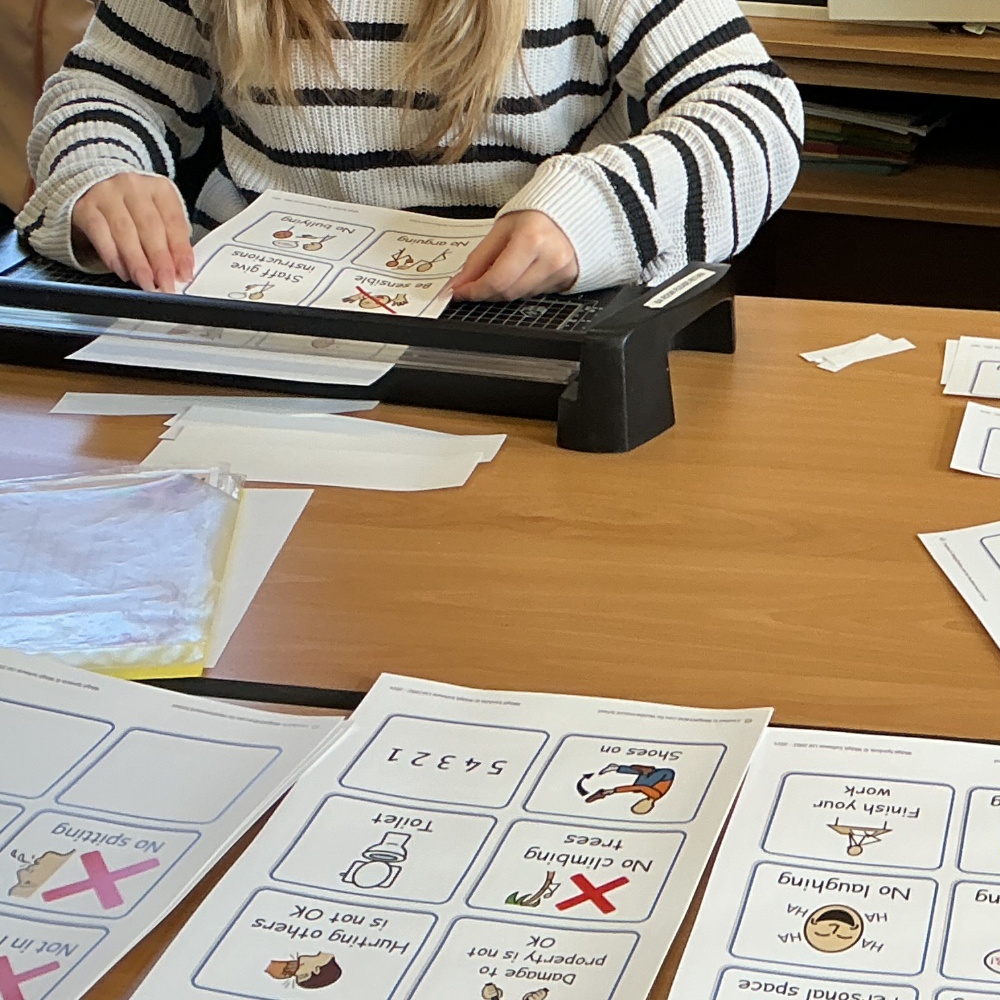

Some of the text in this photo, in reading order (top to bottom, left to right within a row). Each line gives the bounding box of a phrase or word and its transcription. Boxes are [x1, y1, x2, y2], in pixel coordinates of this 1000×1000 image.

[280, 215, 357, 236] No bullying
[396, 235, 470, 247] No arguing
[231, 251, 316, 273] instructions
[230, 261, 304, 285] Staff give
[353, 275, 412, 288] sensible
[387, 746, 509, 776] 5 4 3 2 1
[600, 743, 684, 761] Shoes on
[844, 785, 891, 797] work
[813, 799, 921, 819] Finish your
[371, 813, 434, 833] Toilet
[51, 822, 166, 854] No spitting
[563, 832, 624, 850] trees
[523, 846, 654, 874] No climbing
[778, 871, 911, 901] No laughing
[288, 903, 390, 929] is not OK
[786, 903, 888, 923] HA HA
[10, 937, 33, 953] in
[251, 917, 410, 956] Hurting others
[526, 934, 557, 949] OK
[778, 932, 884, 953] HA HA
[35, 940, 79, 958] Not
[467, 945, 608, 969] property is not
[479, 963, 576, 986] Damage to
[737, 979, 800, 997] space
